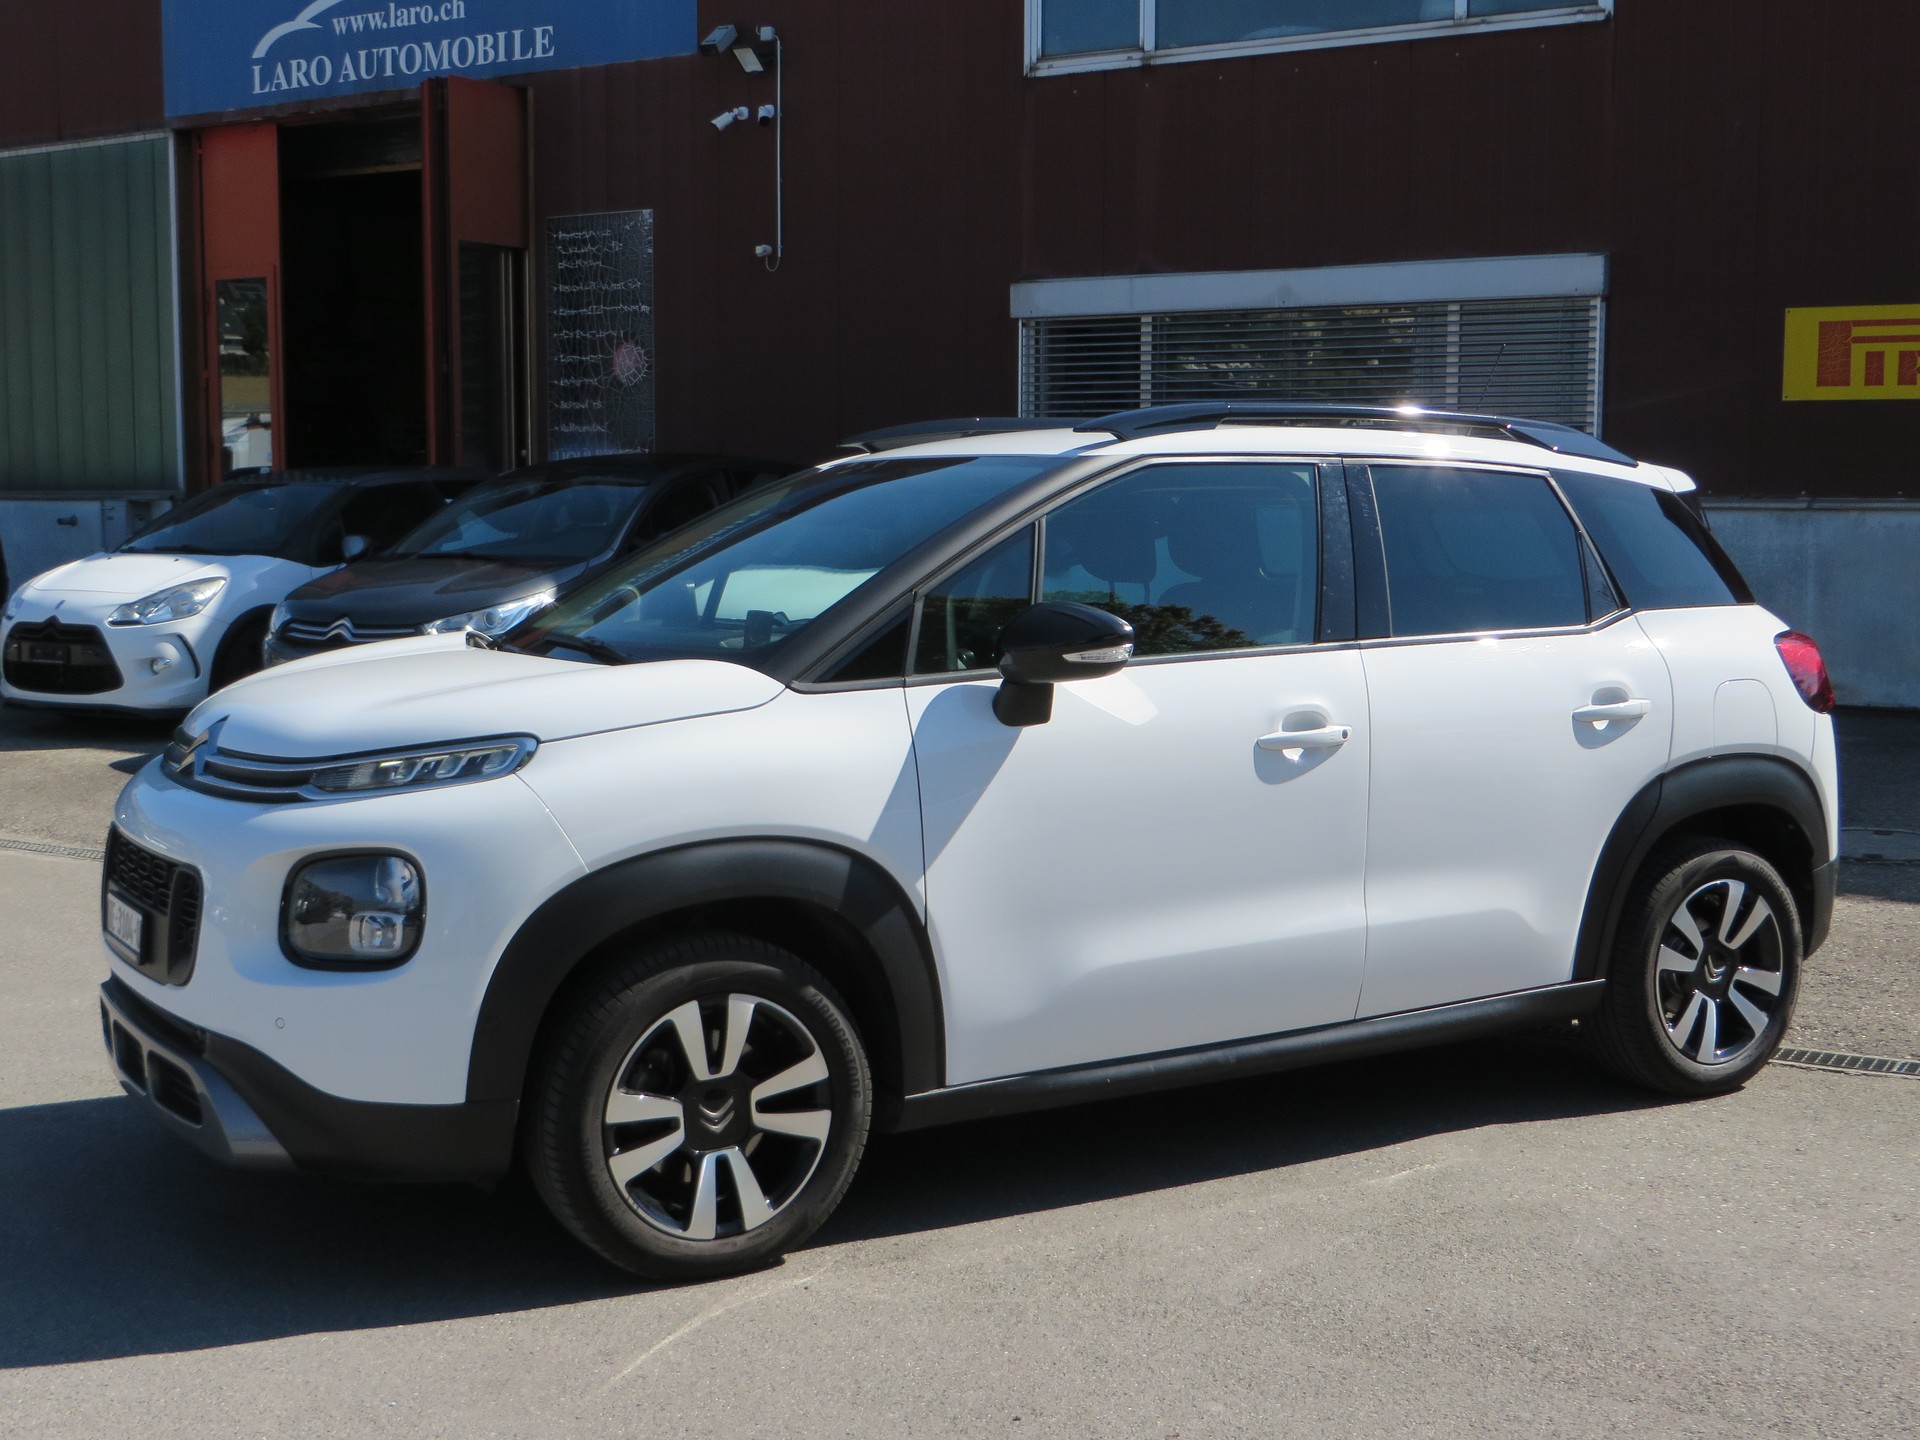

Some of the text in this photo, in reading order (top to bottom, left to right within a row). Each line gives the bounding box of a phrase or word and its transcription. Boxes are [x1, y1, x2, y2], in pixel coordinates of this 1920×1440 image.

[332, 0, 466, 36] www.laro.ch
[252, 25, 555, 95] LARO AUTOMOBILE
